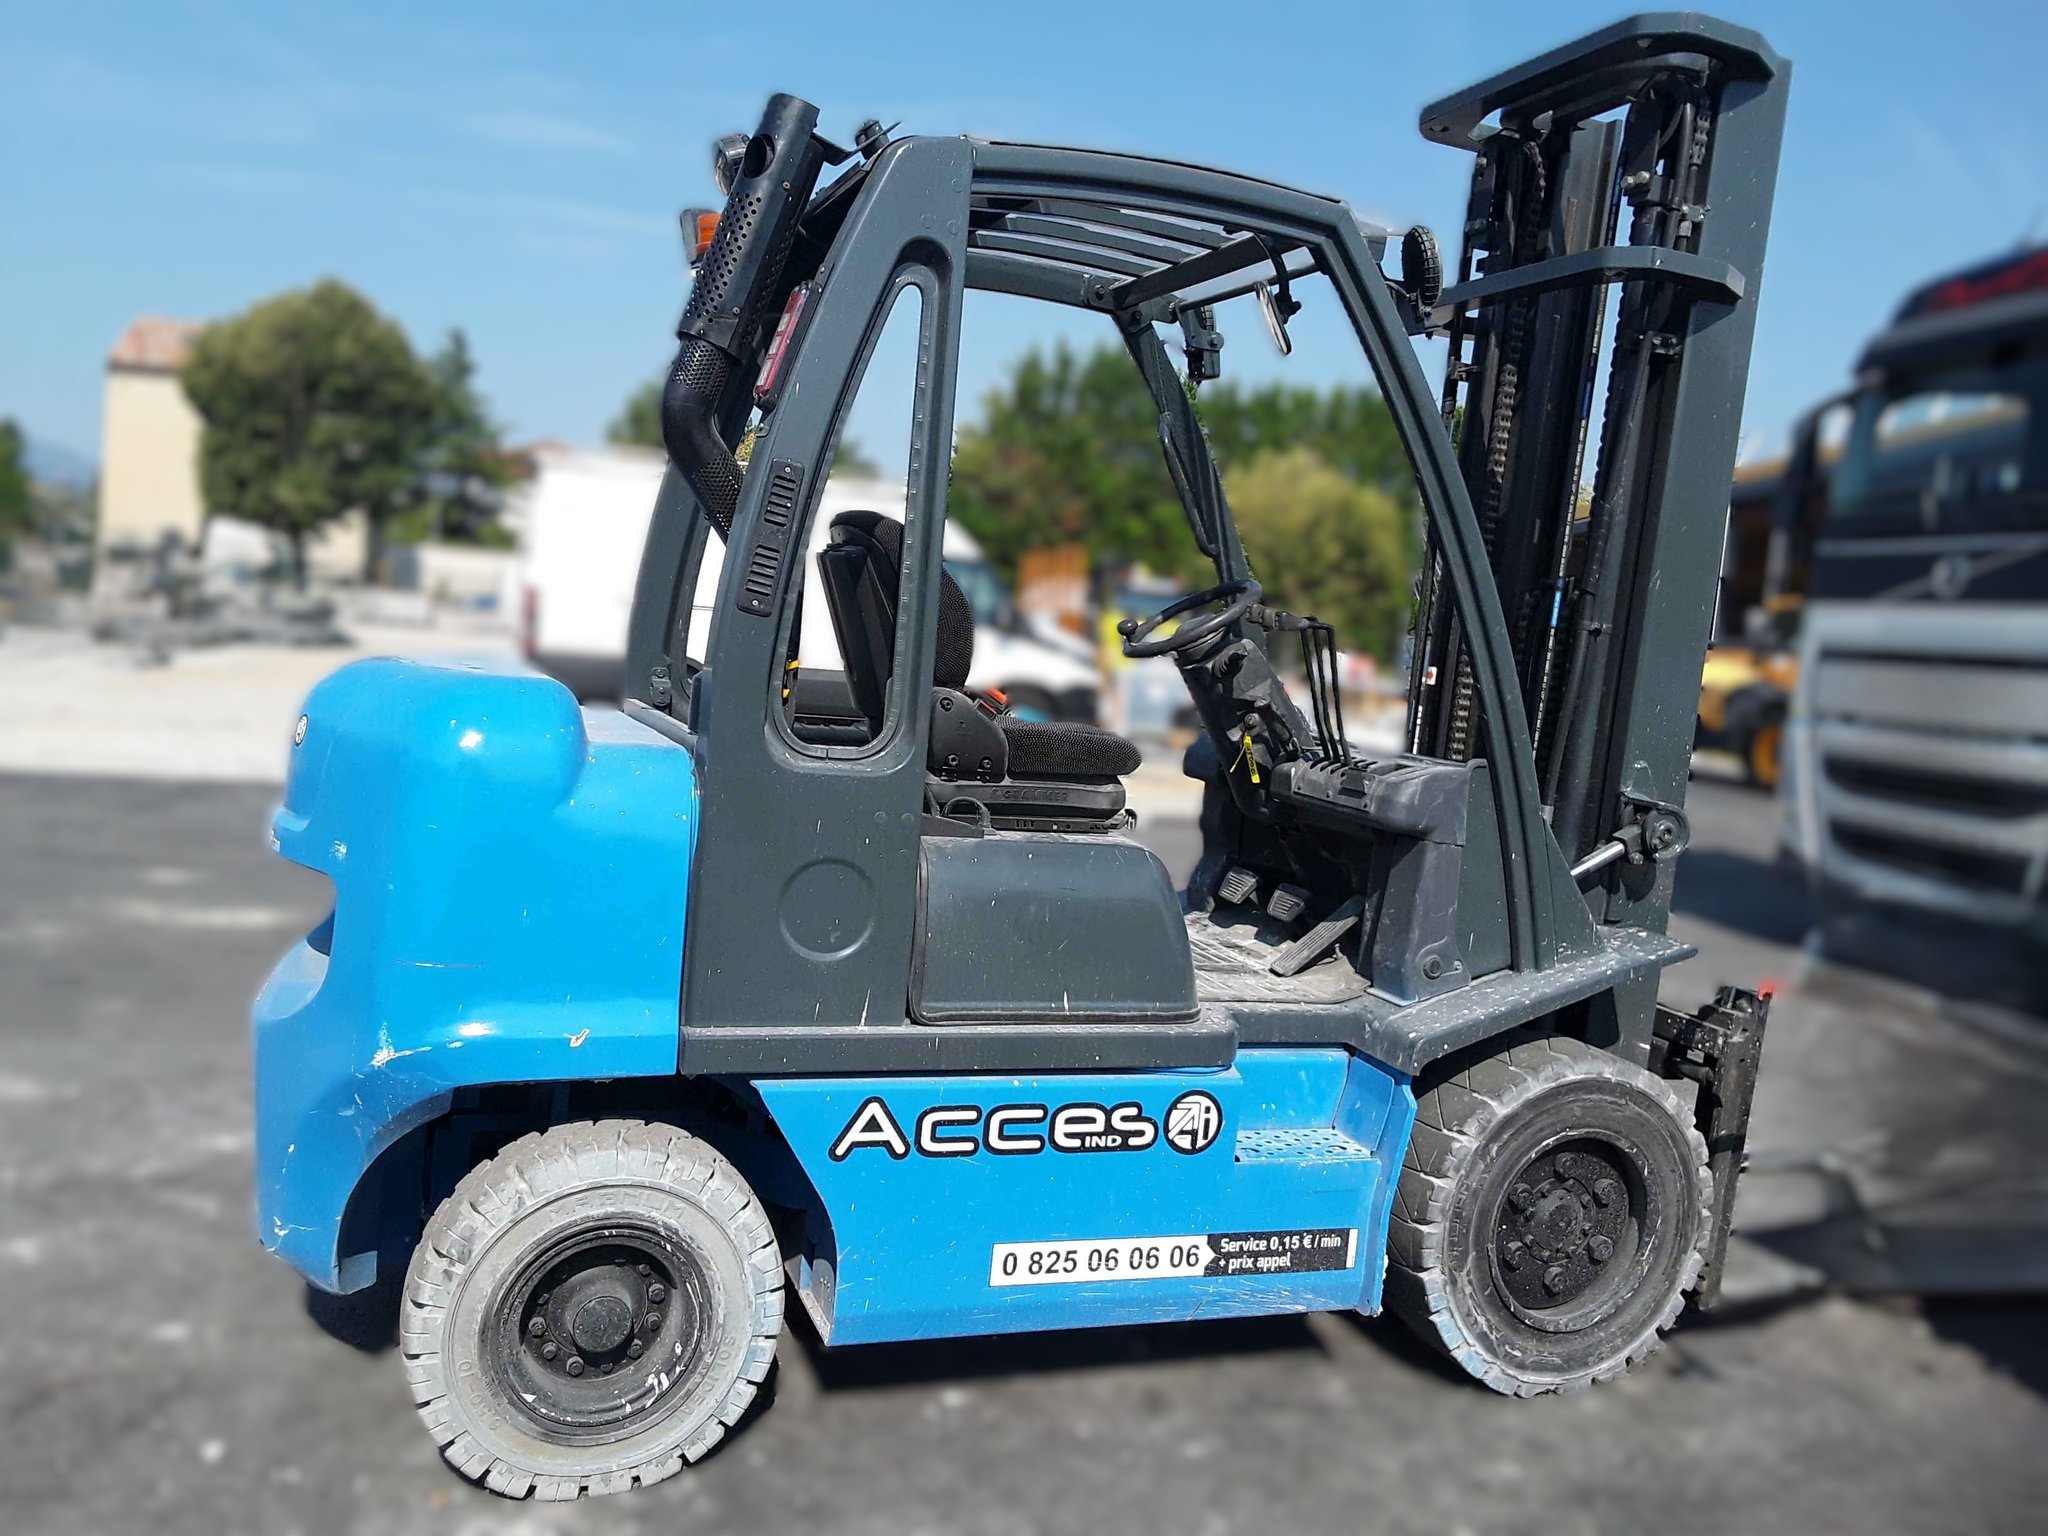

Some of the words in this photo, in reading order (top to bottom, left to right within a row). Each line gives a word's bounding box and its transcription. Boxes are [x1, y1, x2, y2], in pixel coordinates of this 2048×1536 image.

[1085, 1133, 1122, 1149] IND
[1220, 1237, 1267, 1253] Service
[1269, 1235, 1300, 1252] 0,15
[1002, 1252, 1018, 1276] 0
[1028, 1250, 1078, 1275] 825
[1087, 1247, 1120, 1272] 06
[1129, 1246, 1160, 1270] 06
[1170, 1244, 1200, 1268] 06
[1228, 1255, 1255, 1274] prix
[1256, 1252, 1292, 1272] appel
